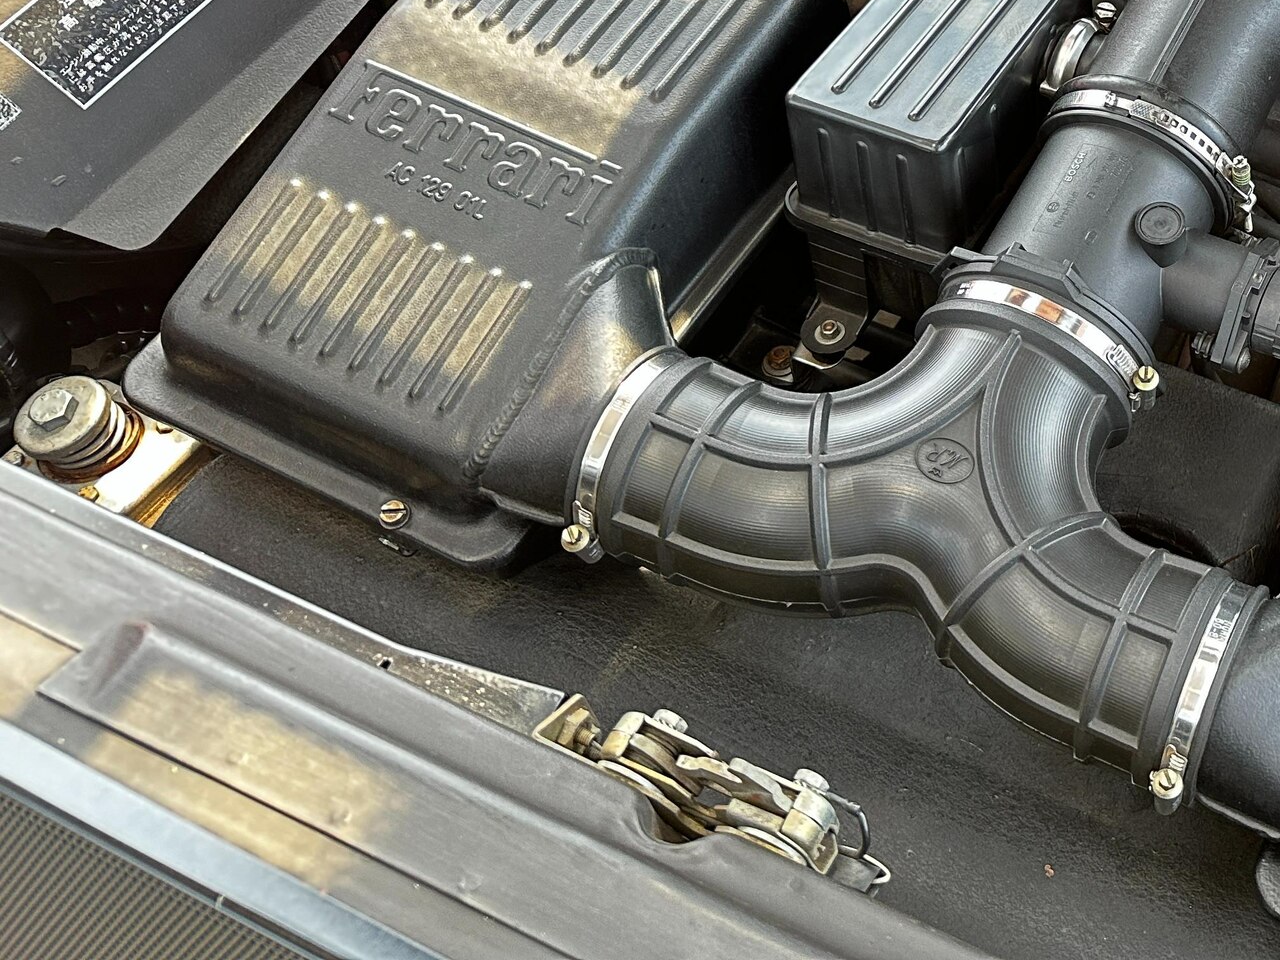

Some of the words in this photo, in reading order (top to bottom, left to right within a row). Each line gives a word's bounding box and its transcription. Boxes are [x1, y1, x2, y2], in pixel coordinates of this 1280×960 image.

[329, 59, 622, 227] Ferrari
[384, 161, 415, 186] AC
[418, 174, 453, 202] 129
[1064, 151, 1087, 183] BOSCH
